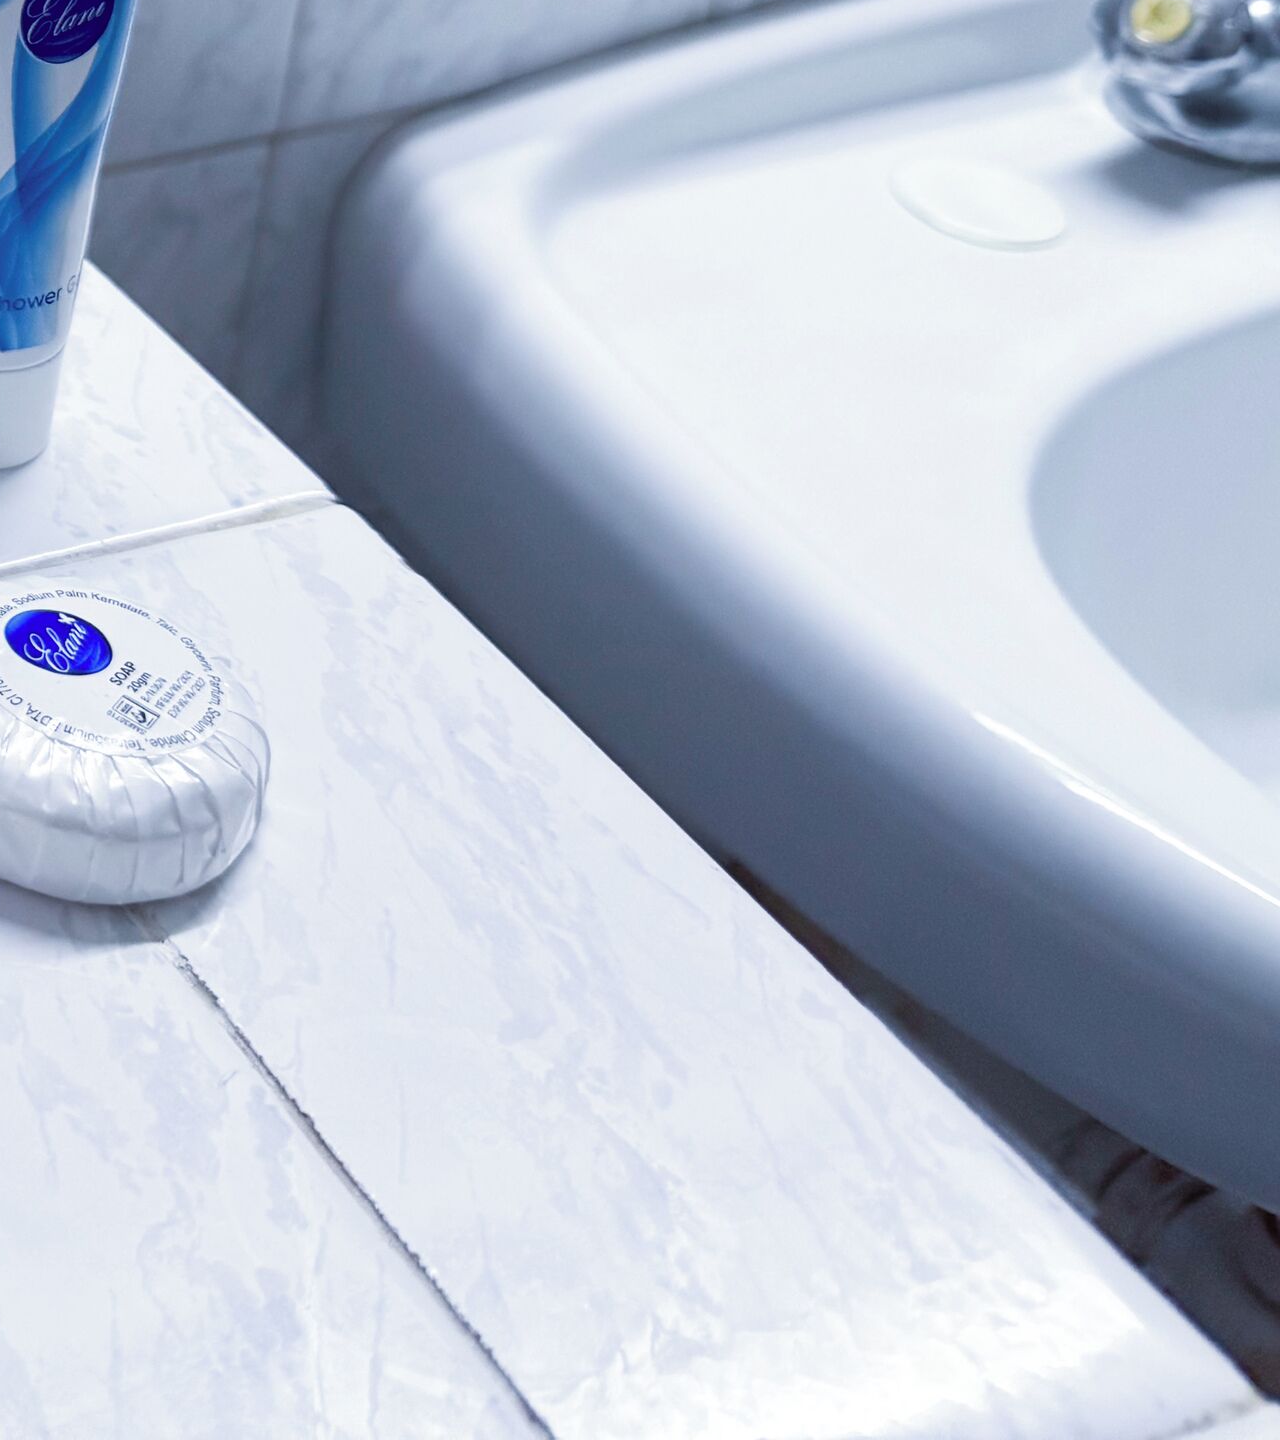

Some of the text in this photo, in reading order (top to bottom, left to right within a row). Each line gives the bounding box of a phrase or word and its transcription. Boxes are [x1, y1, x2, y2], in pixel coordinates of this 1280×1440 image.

[11, 592, 56, 607] Sodium
[55, 589, 88, 599] Palm
[23, 613, 88, 673] Elani
[109, 660, 137, 687] SOAP
[126, 671, 153, 693] 20gm
